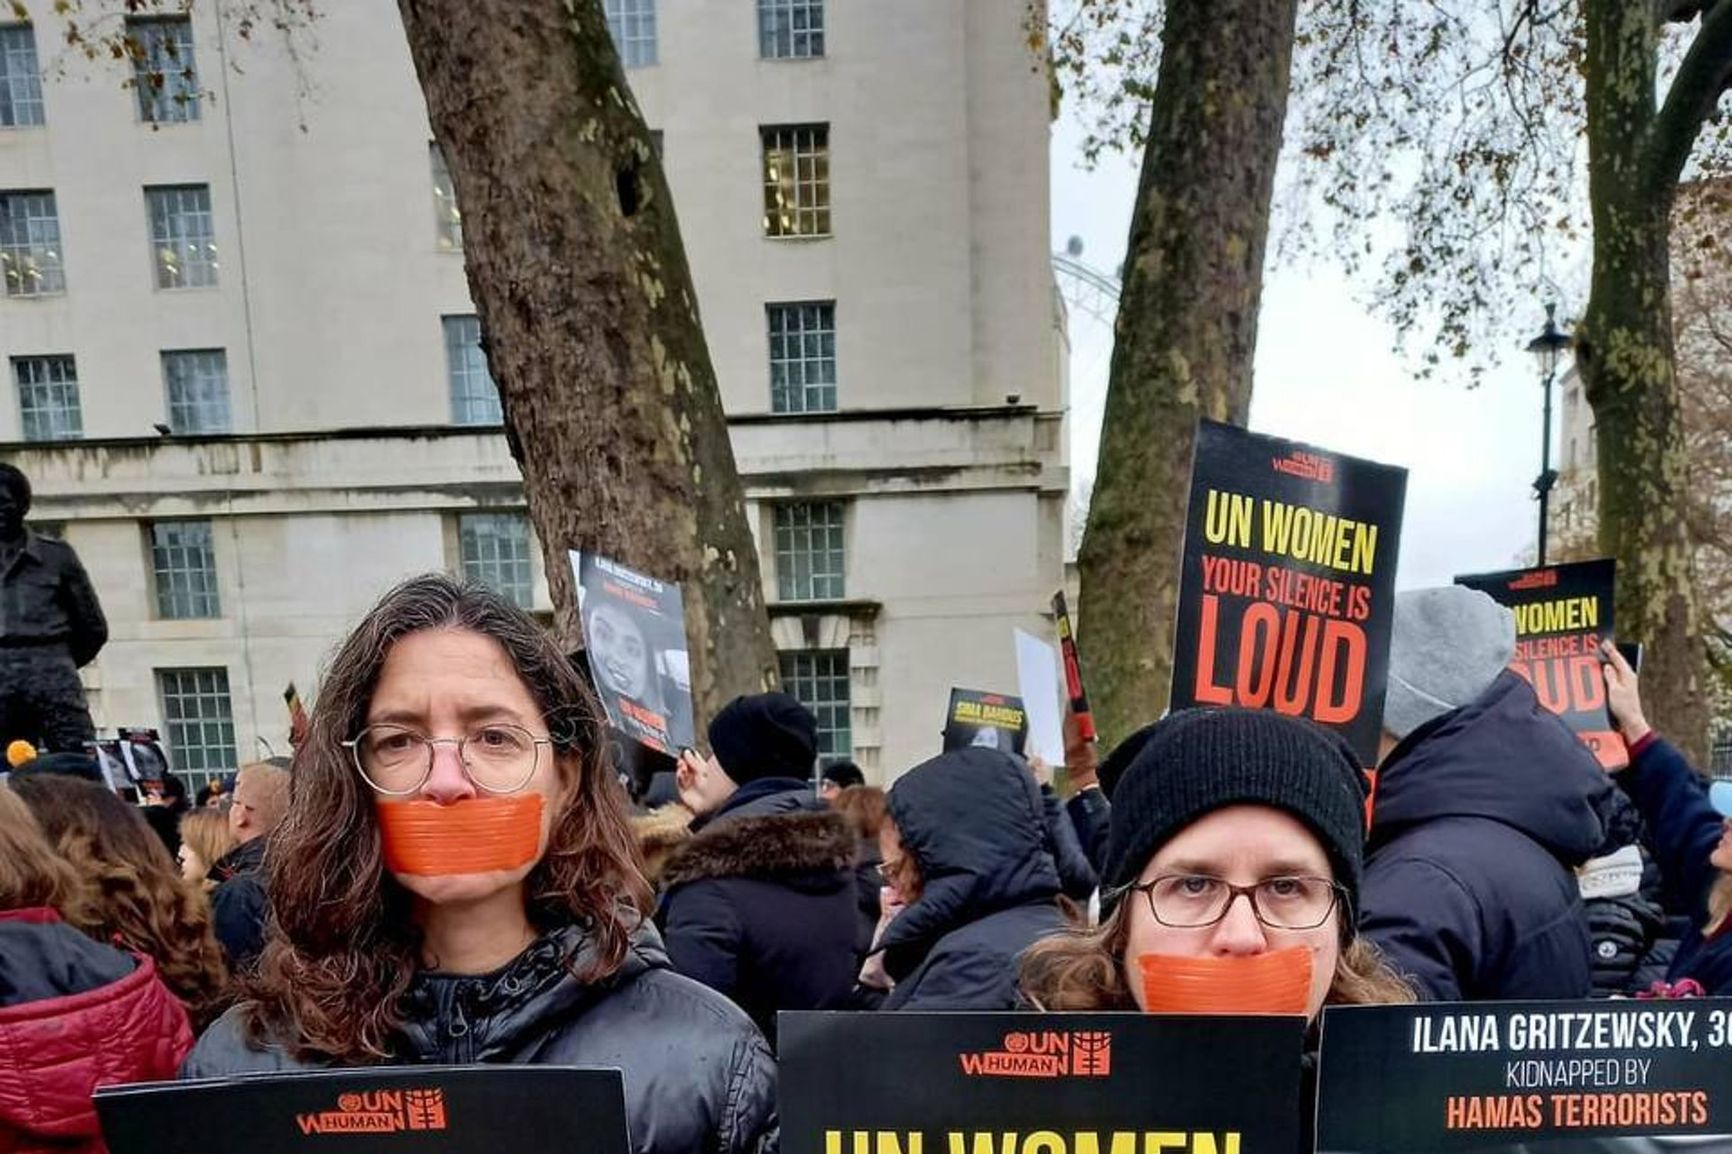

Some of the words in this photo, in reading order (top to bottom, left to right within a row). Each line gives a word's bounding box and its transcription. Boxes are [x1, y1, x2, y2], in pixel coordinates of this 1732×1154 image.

[1205, 489, 1254, 549] UN
[1263, 500, 1378, 575] WOMEN
[1202, 555, 1262, 599] YOUR
[1266, 566, 1344, 617] SILENCE
[1347, 585, 1372, 620] IS
[1195, 594, 1367, 724] LOUD
[1515, 636, 1580, 660] SILENCE
[1583, 633, 1600, 655] IS
[1413, 1014, 1500, 1053] ILANA
[1508, 1010, 1699, 1052] GRITZEWSKY,
[1506, 1058, 1620, 1088] KIDNAPPED
[1624, 1058, 1652, 1085] BY
[1446, 1095, 1542, 1128] HAMAS
[1551, 1092, 1707, 1127] TERRORISTS
